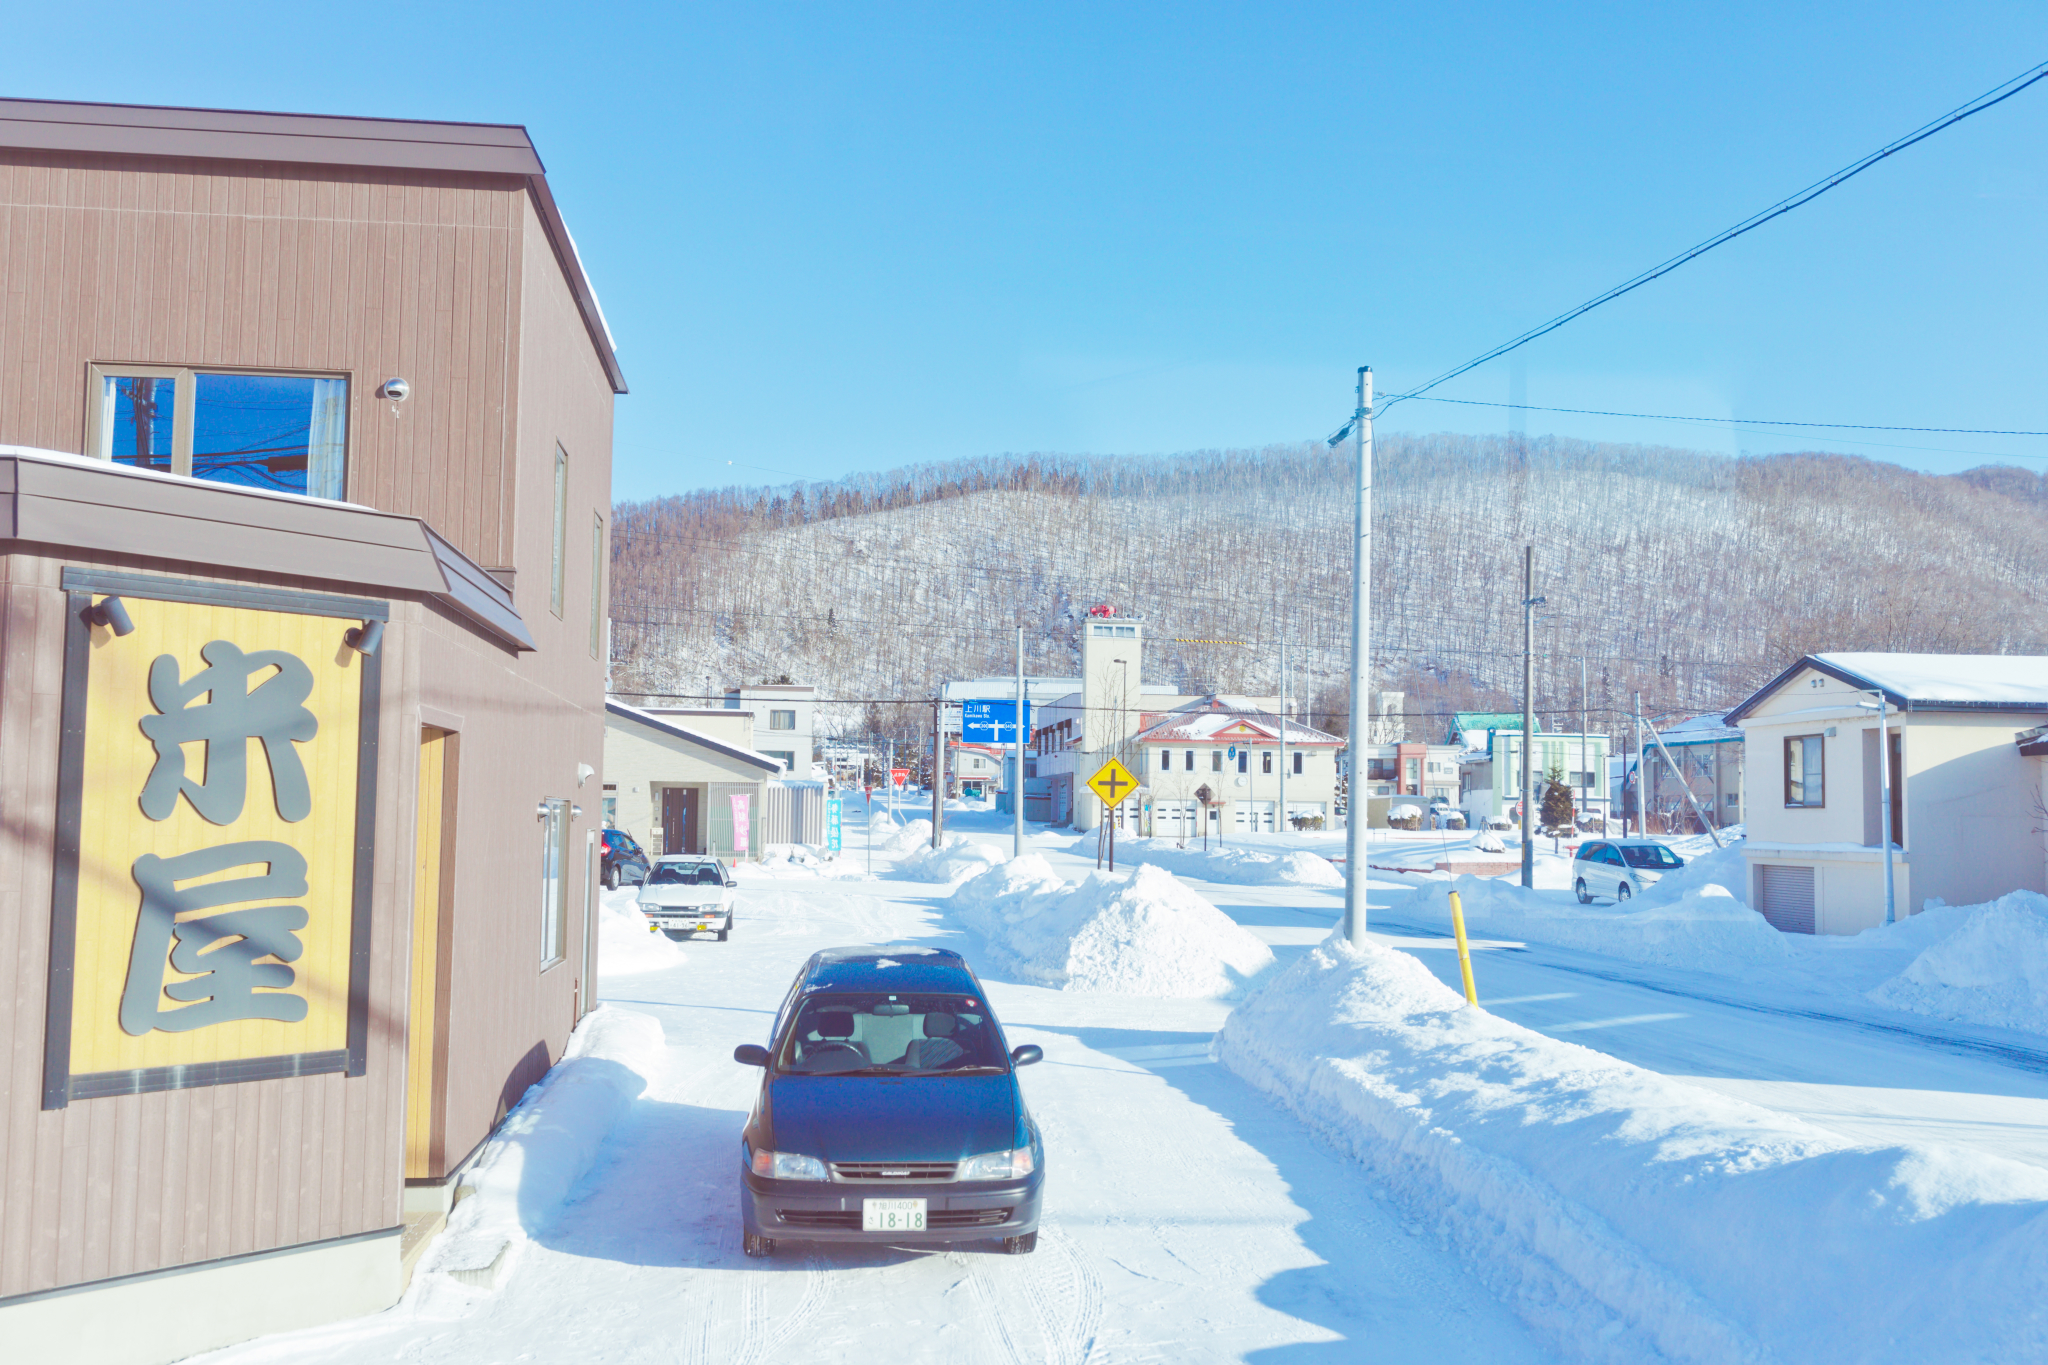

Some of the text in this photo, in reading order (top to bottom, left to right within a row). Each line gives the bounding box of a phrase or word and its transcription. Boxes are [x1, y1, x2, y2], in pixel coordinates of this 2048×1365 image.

[964, 704, 991, 713] 上川駅
[879, 1212, 923, 1229] 18-18
